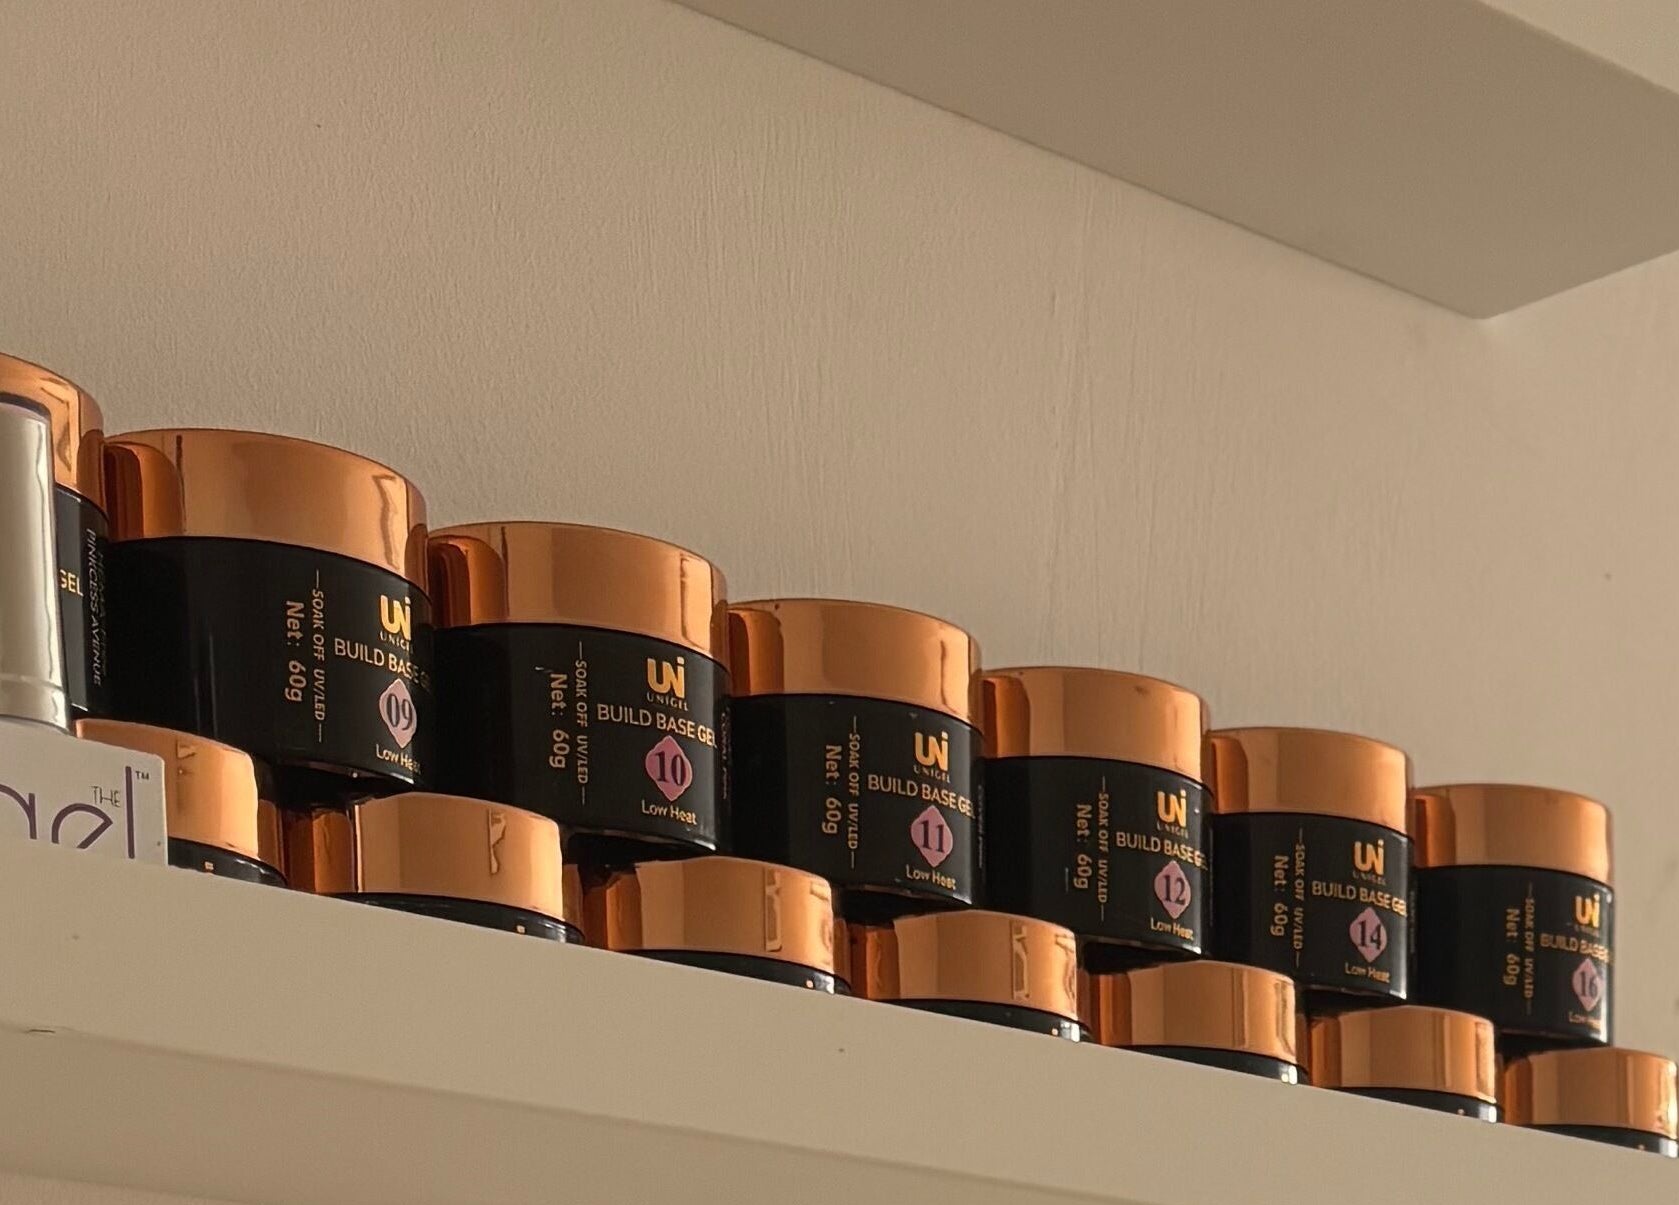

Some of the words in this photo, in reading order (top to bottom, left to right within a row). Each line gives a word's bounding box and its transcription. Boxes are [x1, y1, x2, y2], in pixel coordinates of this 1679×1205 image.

[312, 589, 325, 630] SOAK
[313, 634, 325, 661] OFF
[334, 638, 385, 666] BUILD
[284, 660, 307, 702] 60g
[313, 668, 325, 721] UV/LED
[575, 660, 587, 697] SOAK
[386, 693, 413, 730] 09
[576, 702, 588, 727] OFF
[597, 704, 651, 726] BUILD
[656, 712, 695, 738] BASE
[376, 743, 399, 763] Low
[549, 729, 570, 769] 60g
[576, 735, 588, 784] UV/LED
[848, 733, 860, 768] SOAK
[655, 751, 687, 786] 10
[848, 773, 860, 796] OFF
[90, 786, 121, 808] THE
[868, 774, 918, 796] BUILD
[921, 784, 957, 809] BASE
[641, 800, 668, 817] Low
[670, 807, 697, 825] Heat
[821, 797, 842, 834] 60g
[848, 803, 859, 849] UV/LED
[1098, 793, 1109, 827] SOAK
[919, 820, 945, 853] 11
[1116, 831, 1161, 853] BUILD
[1164, 839, 1194, 863] BASE
[905, 864, 930, 880] Low
[1073, 854, 1093, 889] 60g
[1162, 874, 1186, 906] 12
[1312, 880, 1356, 900] BUILD
[1359, 887, 1391, 909] BASE
[1270, 903, 1289, 937] 60g
[1358, 920, 1382, 950] 14
[1580, 971, 1599, 998] 16
